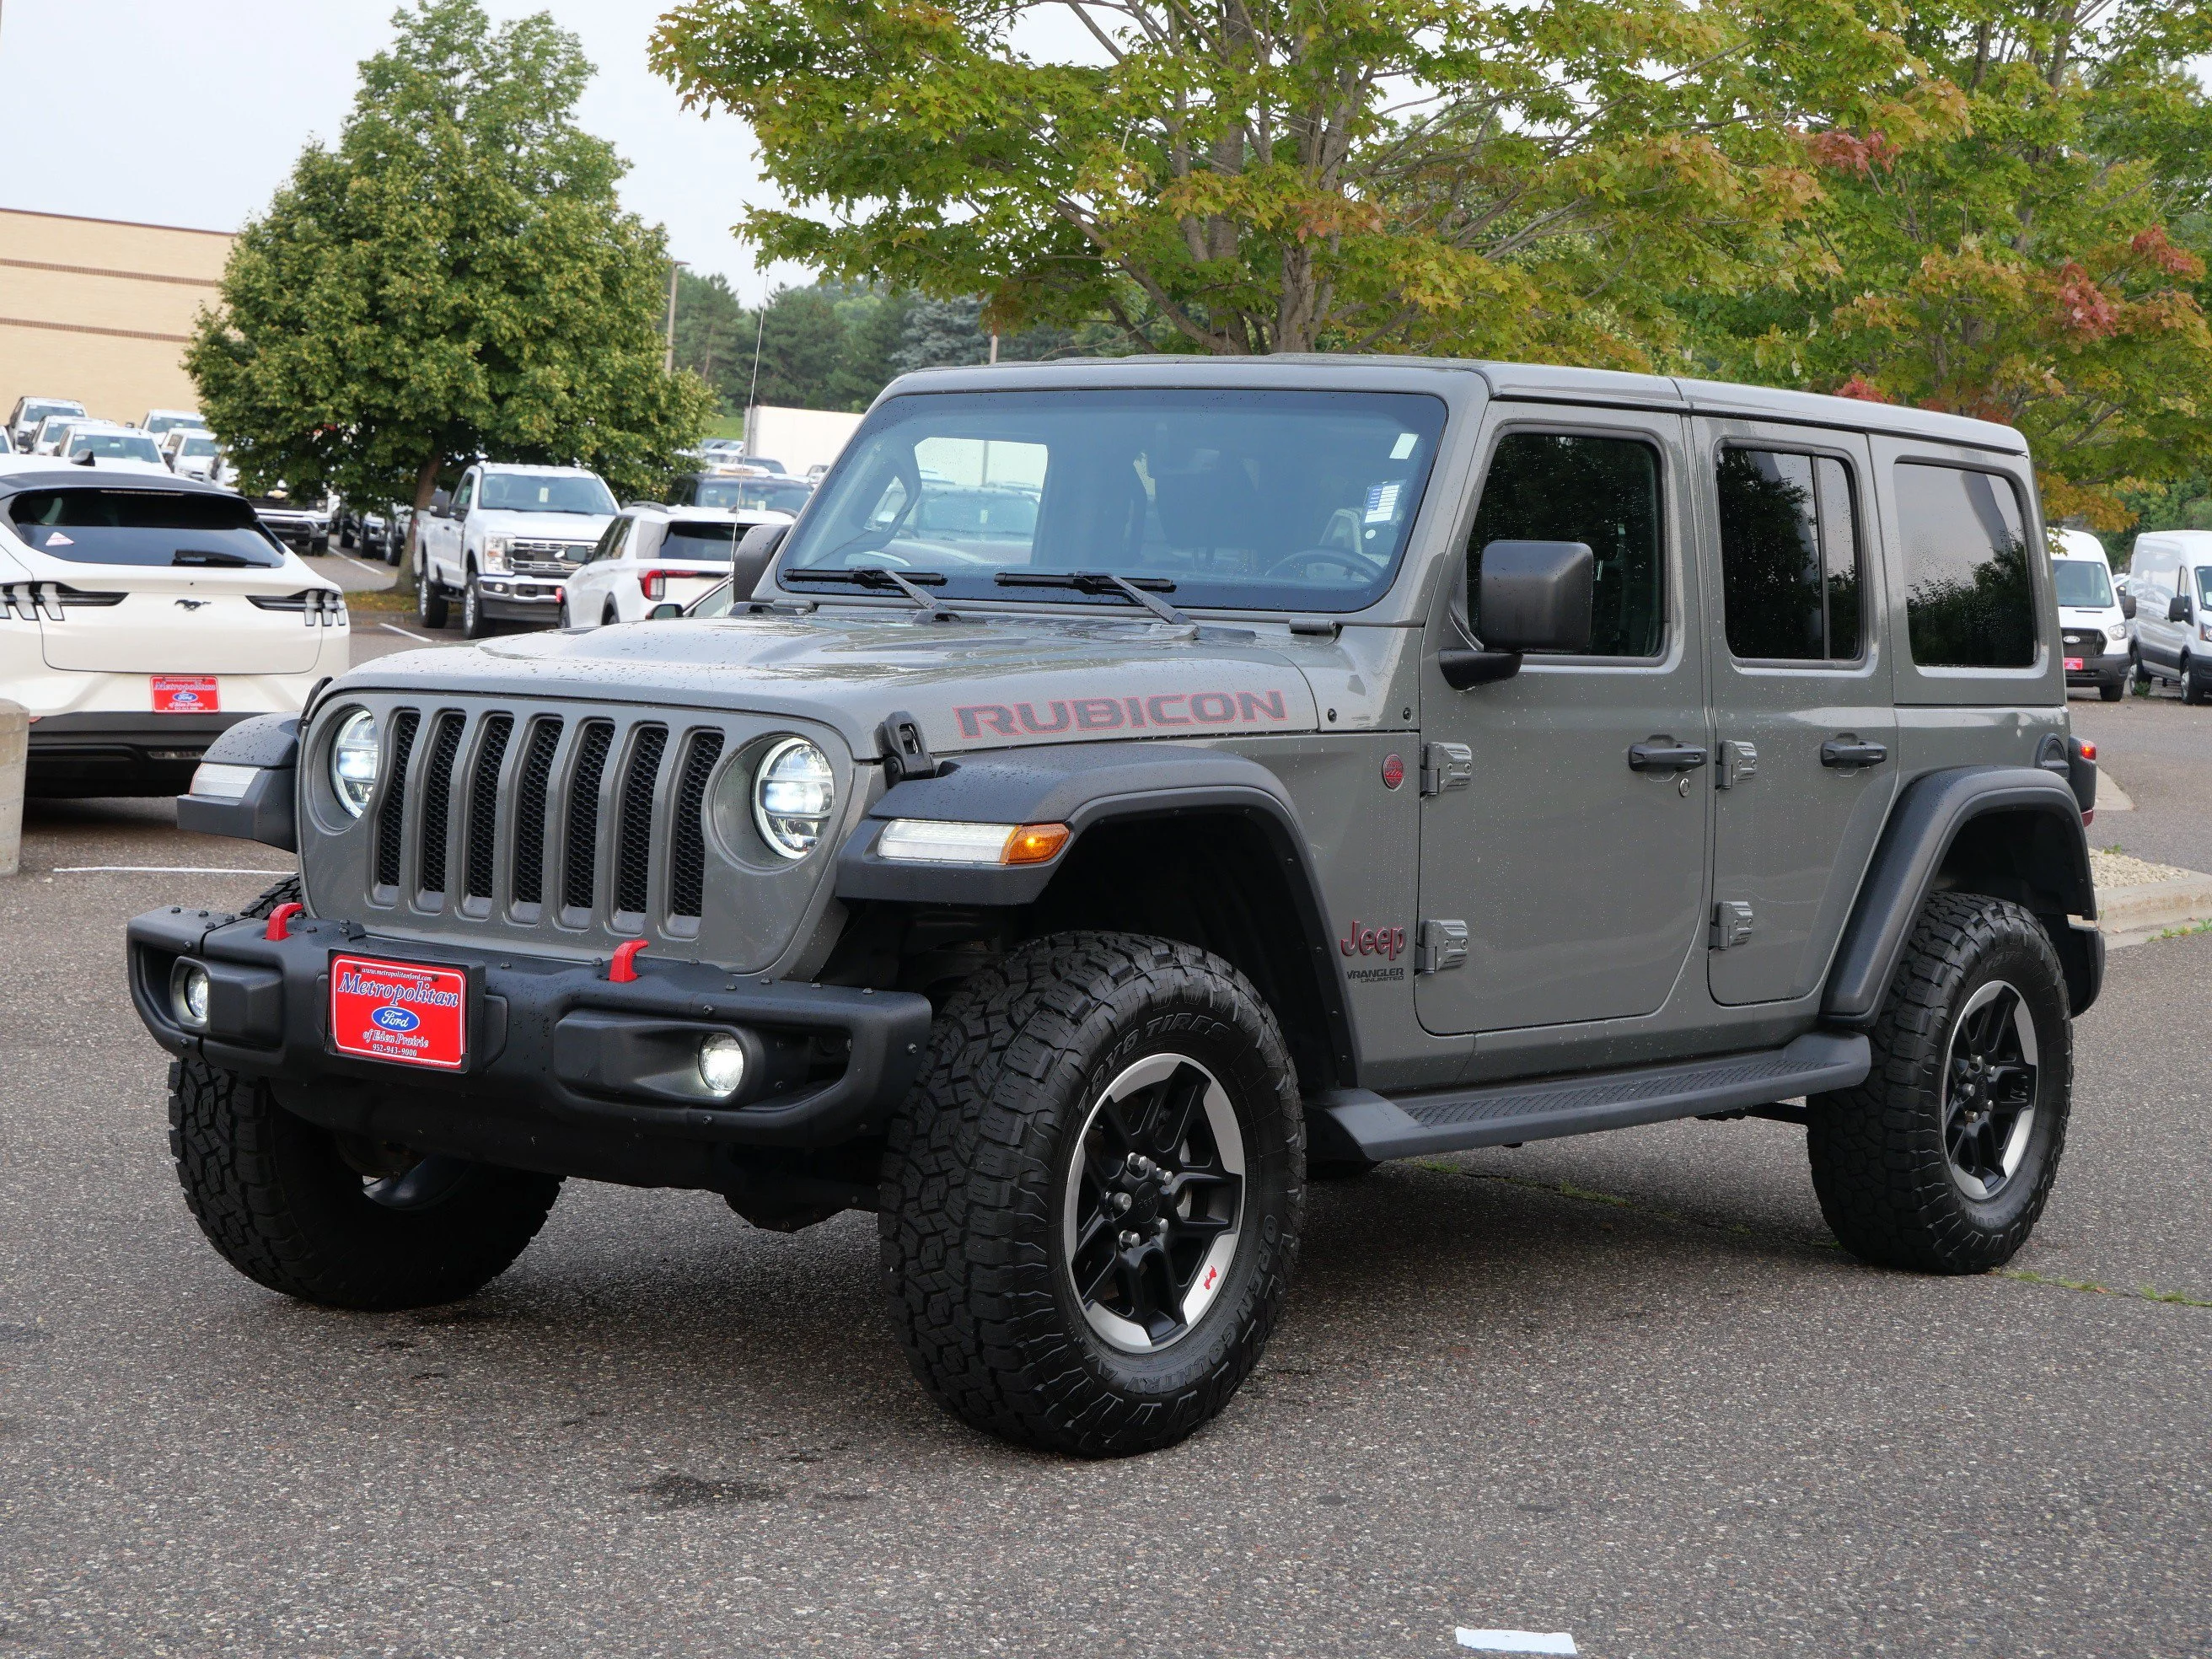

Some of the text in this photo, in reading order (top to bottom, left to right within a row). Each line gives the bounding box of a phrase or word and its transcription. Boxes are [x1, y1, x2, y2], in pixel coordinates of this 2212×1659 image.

[953, 690, 1288, 738] RUBICON
[1341, 921, 1407, 960] Jeep
[362, 968, 432, 981] www.metropolitanford.com
[1347, 968, 1404, 980] WRANGLER
[1361, 975, 1404, 984] UNLIMITED
[338, 973, 459, 1007] Metropolitan
[381, 1010, 410, 1028] Ford
[1145, 1012, 1231, 1040] TIRES
[362, 1029, 428, 1048] of Eden Prairie
[373, 1044, 417, 1057] 952-943-9000
[1237, 1215, 1278, 1323] OPEN
[1125, 1321, 1238, 1395] COUNTRY
